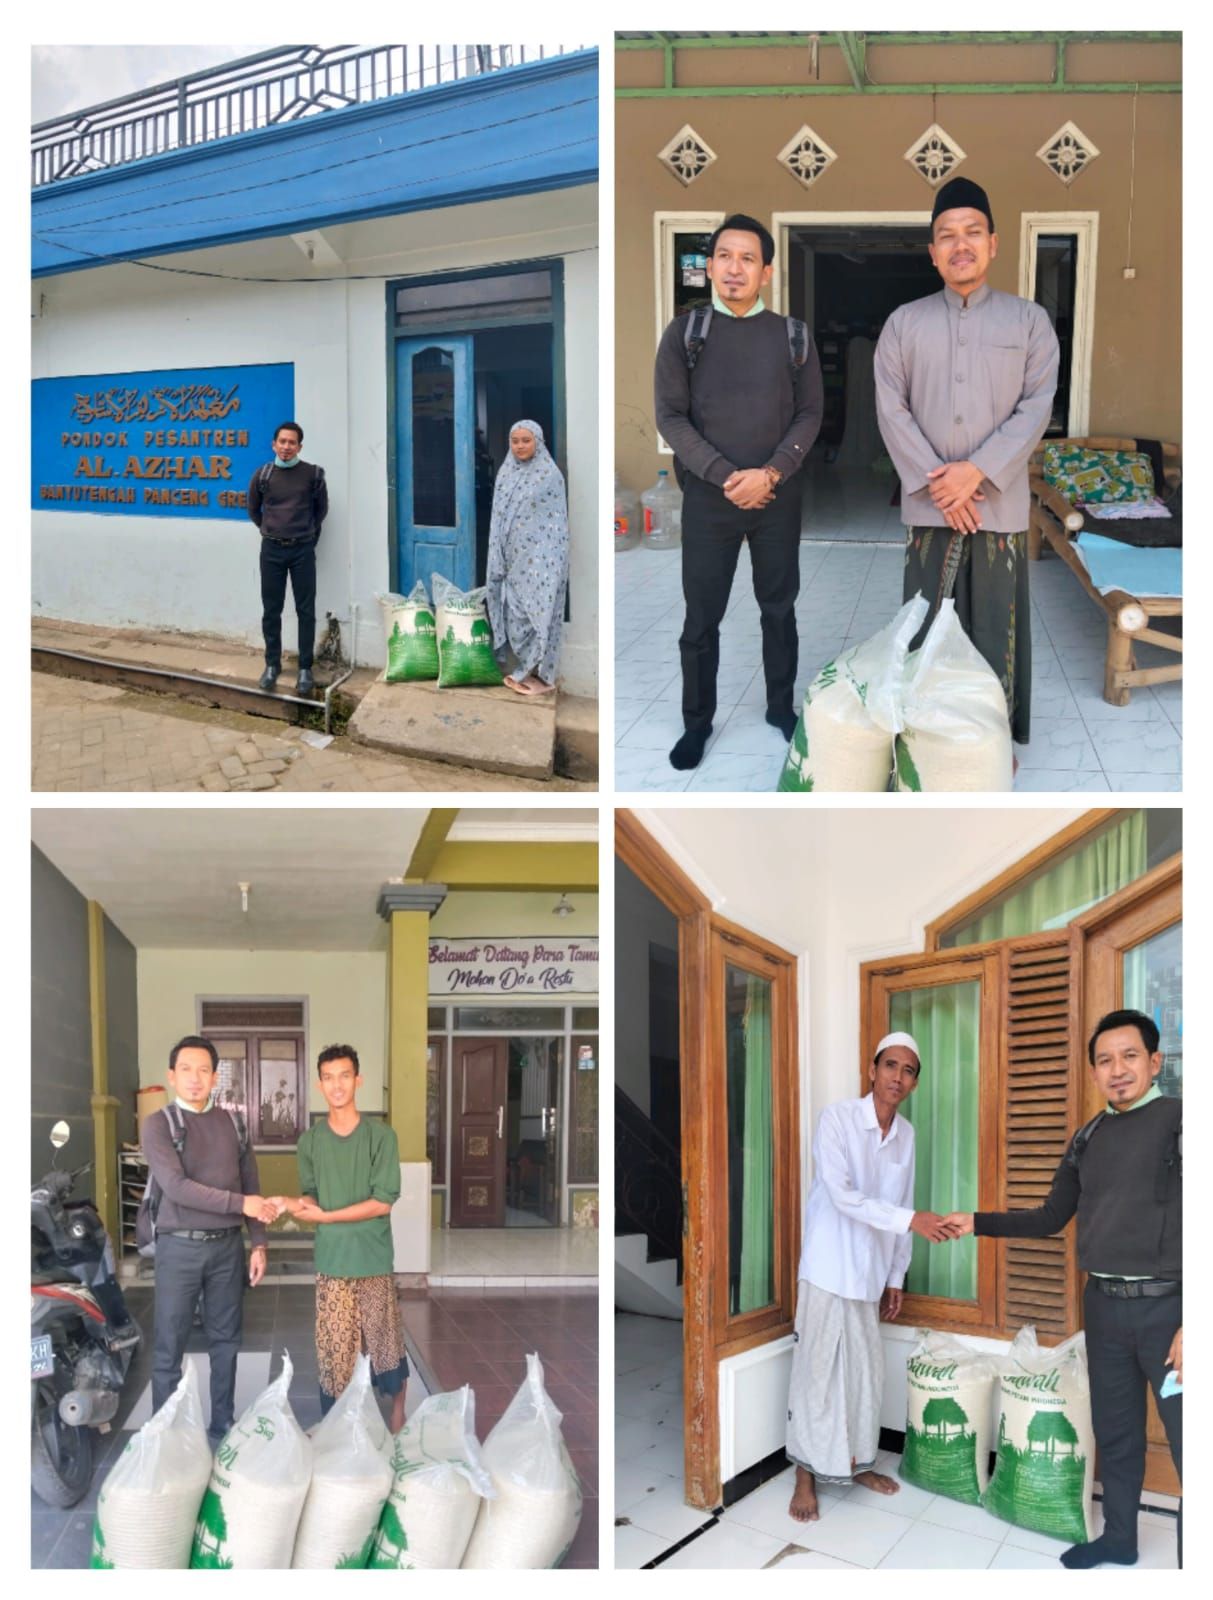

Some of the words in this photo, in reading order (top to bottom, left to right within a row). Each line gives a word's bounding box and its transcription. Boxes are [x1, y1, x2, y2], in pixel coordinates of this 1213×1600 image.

[62, 431, 128, 447] PONDOK
[145, 431, 248, 447] PESANTREN
[40, 486, 136, 503] BANYUTENGAH
[144, 489, 208, 506] PANCENG
[218, 492, 249, 507] GRE
[429, 945, 480, 963] Selamat
[483, 944, 530, 969] Datang
[532, 945, 565, 963] Para
[447, 968, 496, 992] Mohon
[538, 967, 575, 990] Restu
